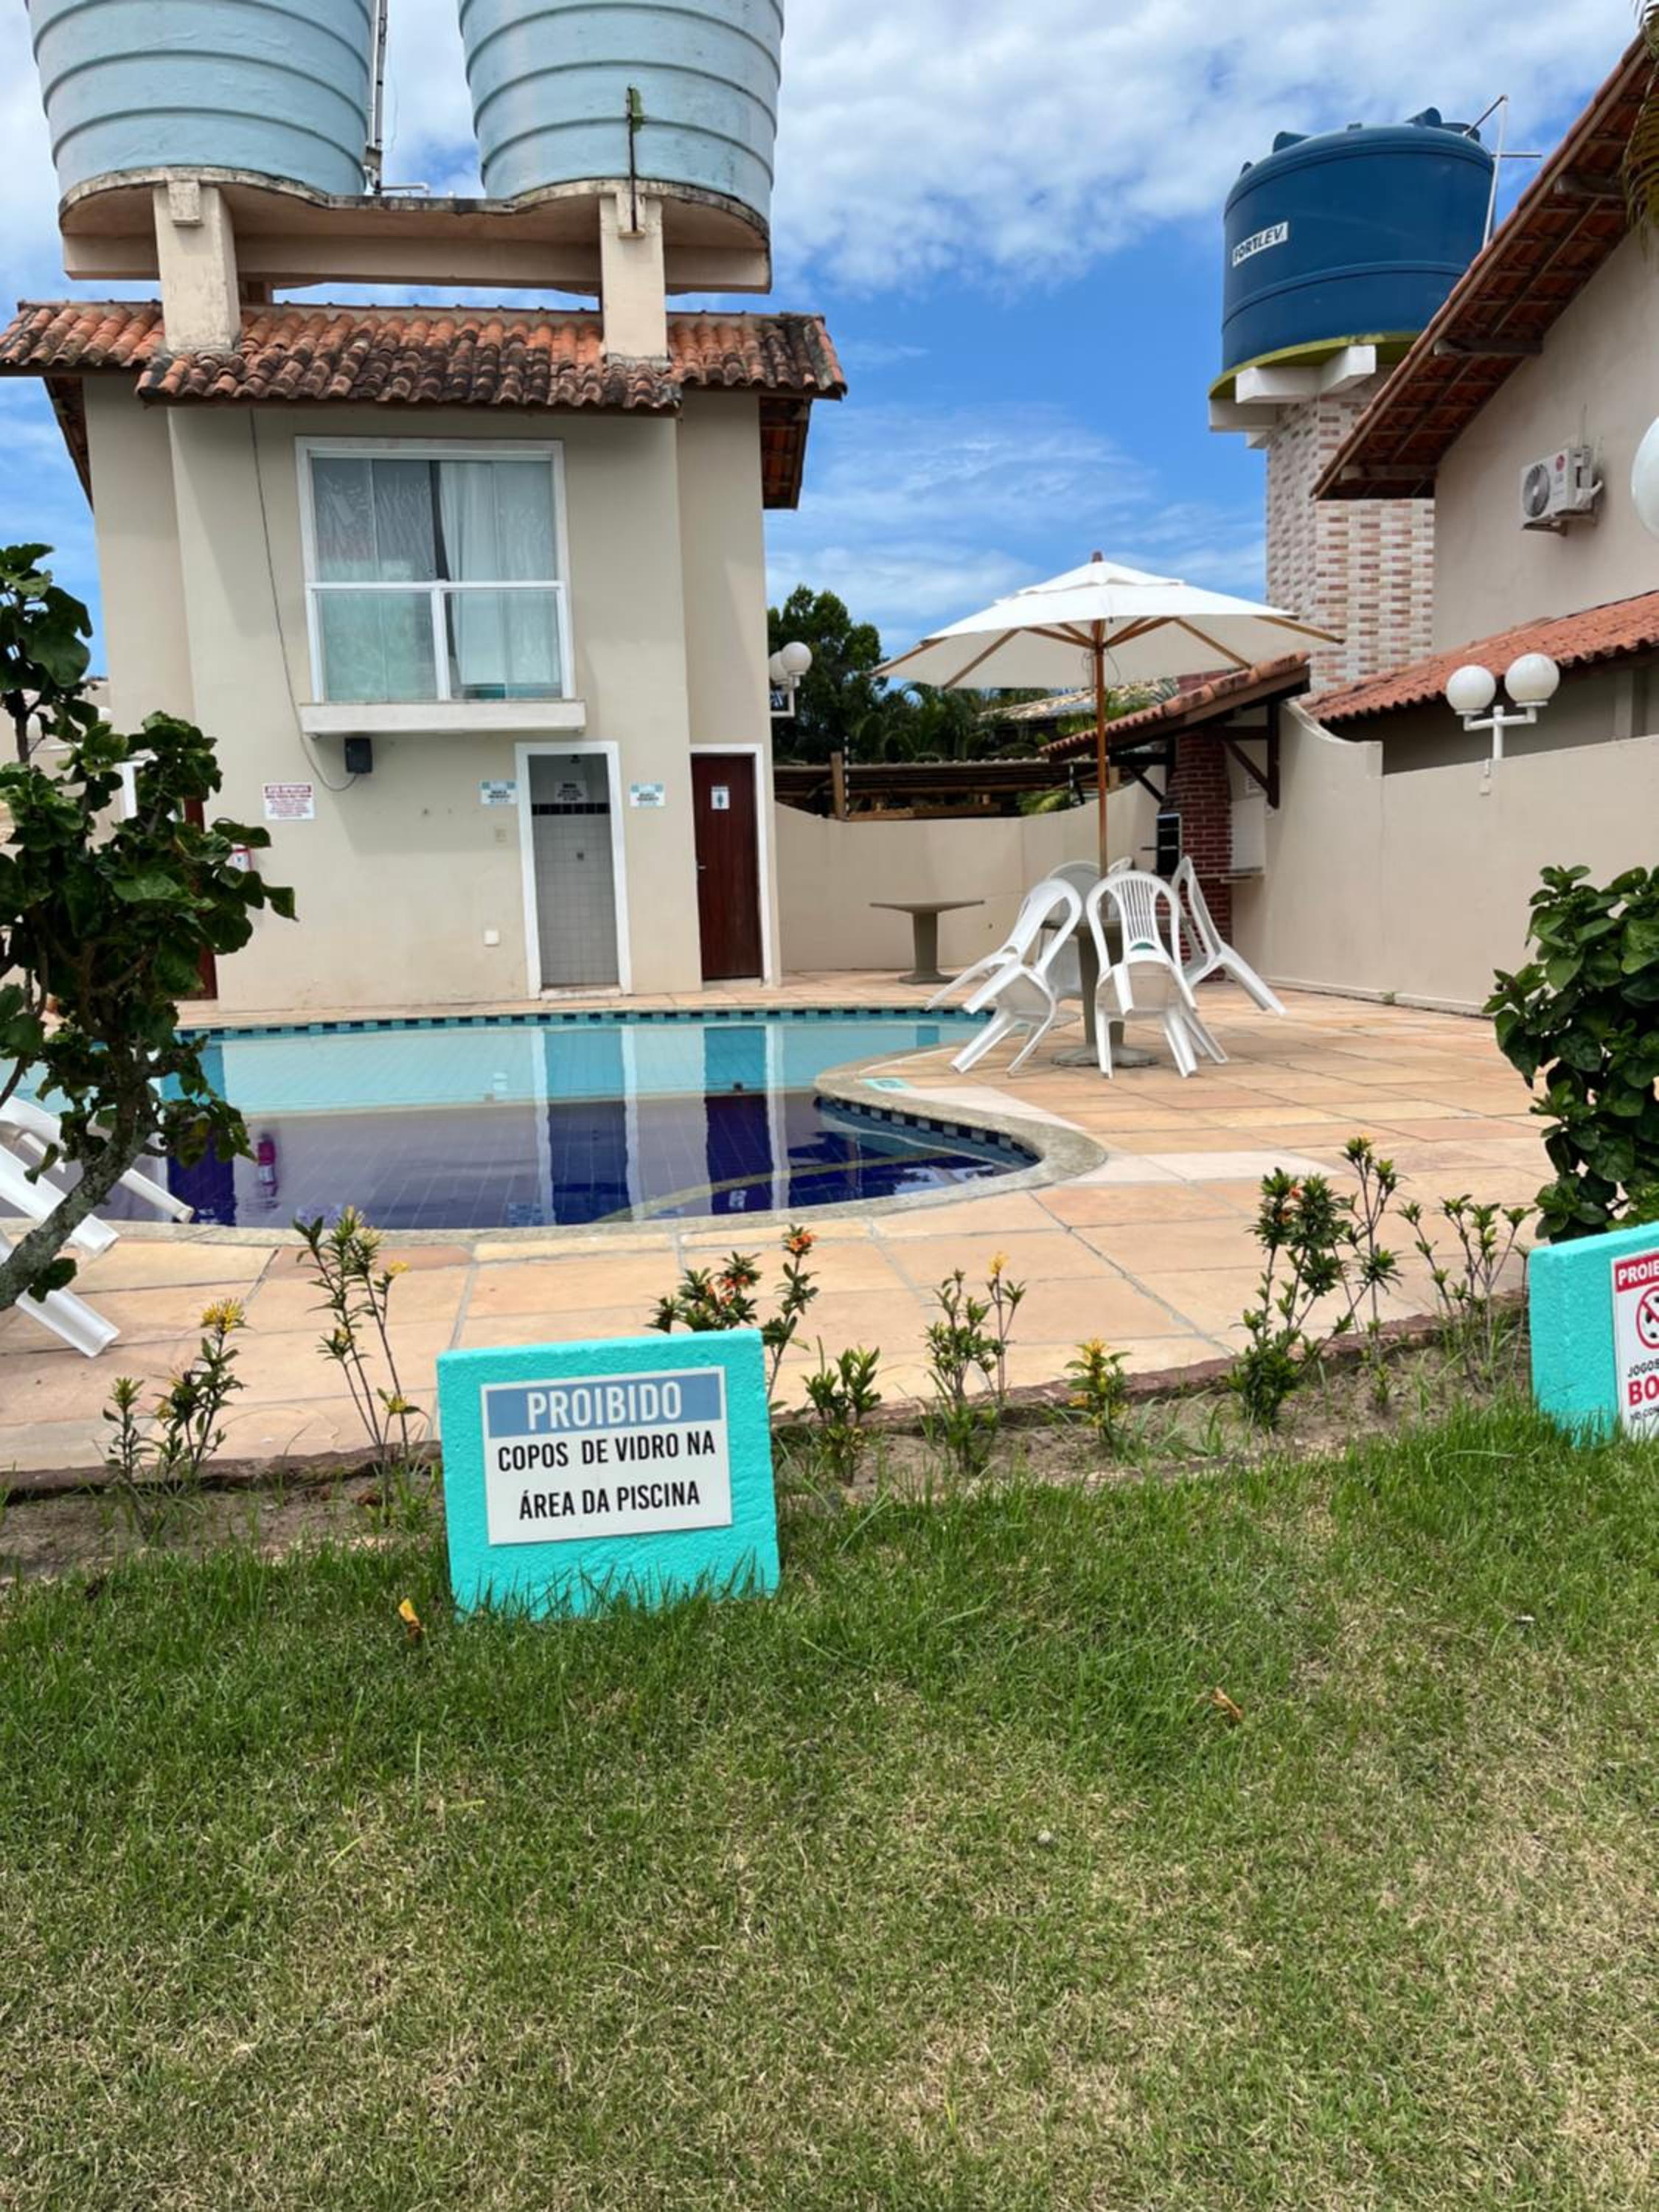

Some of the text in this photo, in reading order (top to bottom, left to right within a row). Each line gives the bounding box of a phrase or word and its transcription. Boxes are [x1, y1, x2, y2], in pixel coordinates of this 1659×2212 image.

[1234, 224, 1284, 263] FORTLEV
[527, 1381, 681, 1430] PROIBIDO
[1628, 1376, 1659, 1406] BO
[498, 1430, 715, 1472] COPOS DE VIDRO NA
[519, 1481, 700, 1520] ÁREA DA PISCINA
